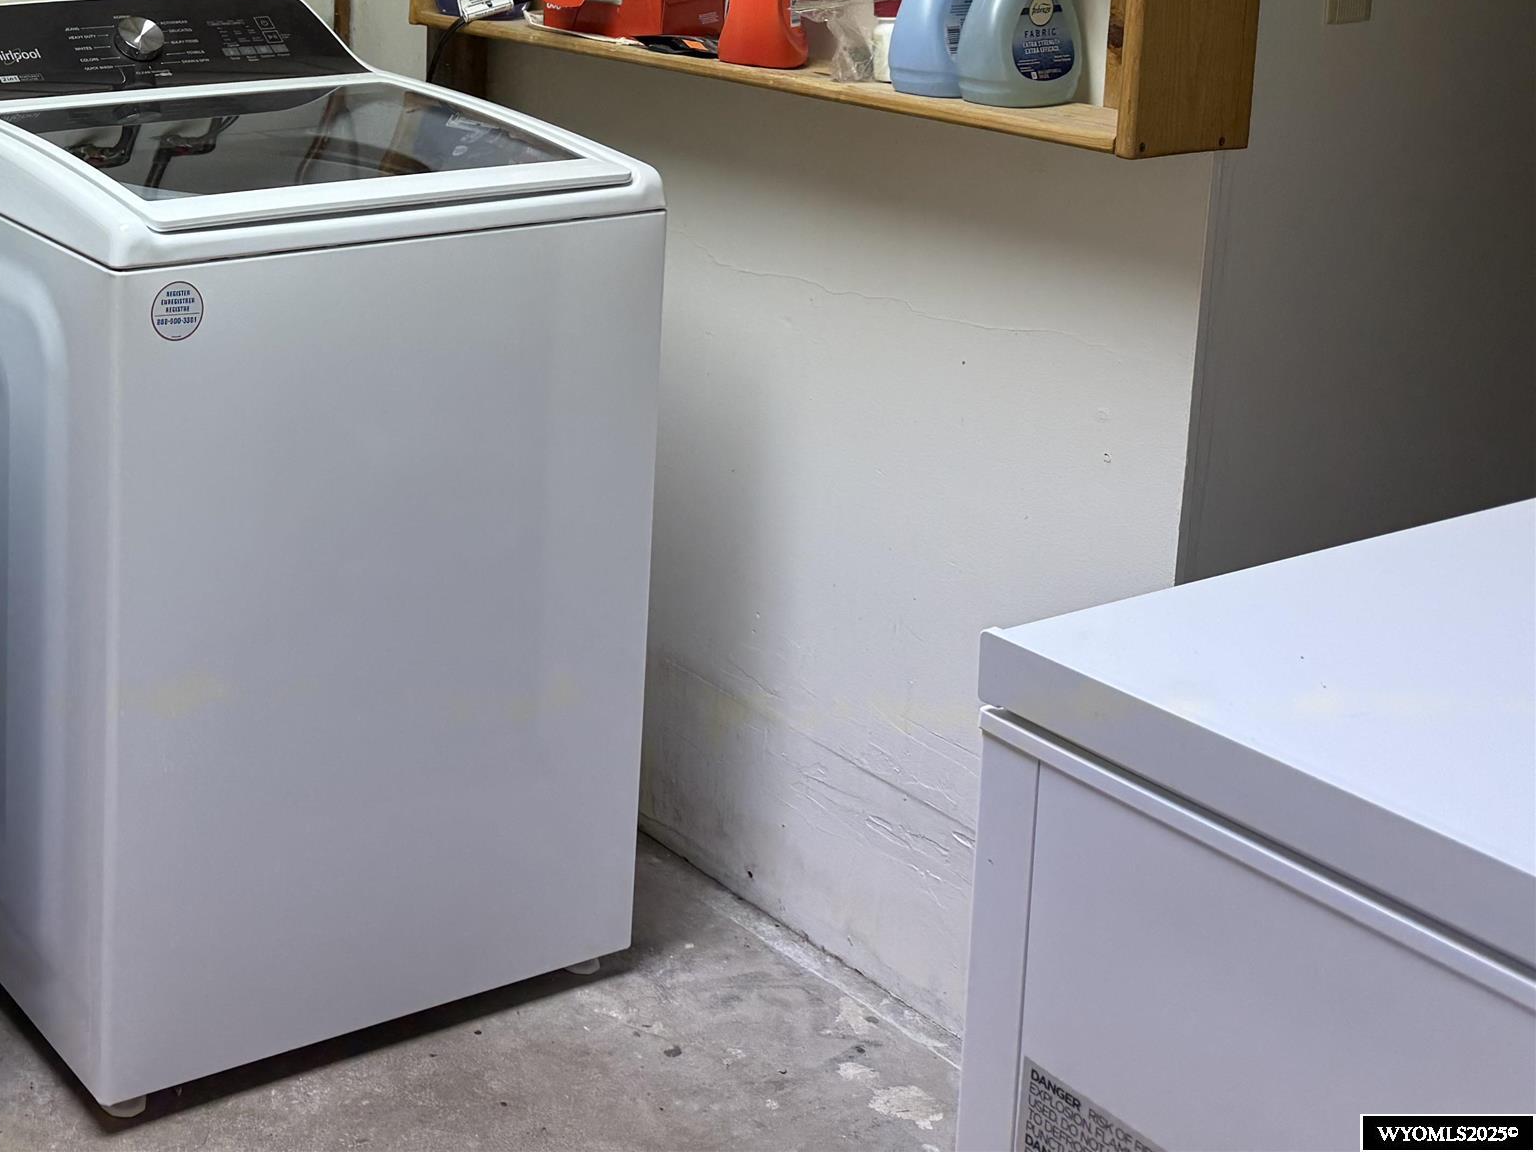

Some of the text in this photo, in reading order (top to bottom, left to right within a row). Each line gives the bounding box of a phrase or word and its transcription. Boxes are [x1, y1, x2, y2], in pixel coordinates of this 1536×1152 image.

[1024, 28, 1056, 38] FABRIC
[1030, 1067, 1082, 1112] DANGER
[1088, 1108, 1114, 1135] RISK
[1115, 1127, 1134, 1145] OF
[1028, 1107, 1043, 1127] TO
